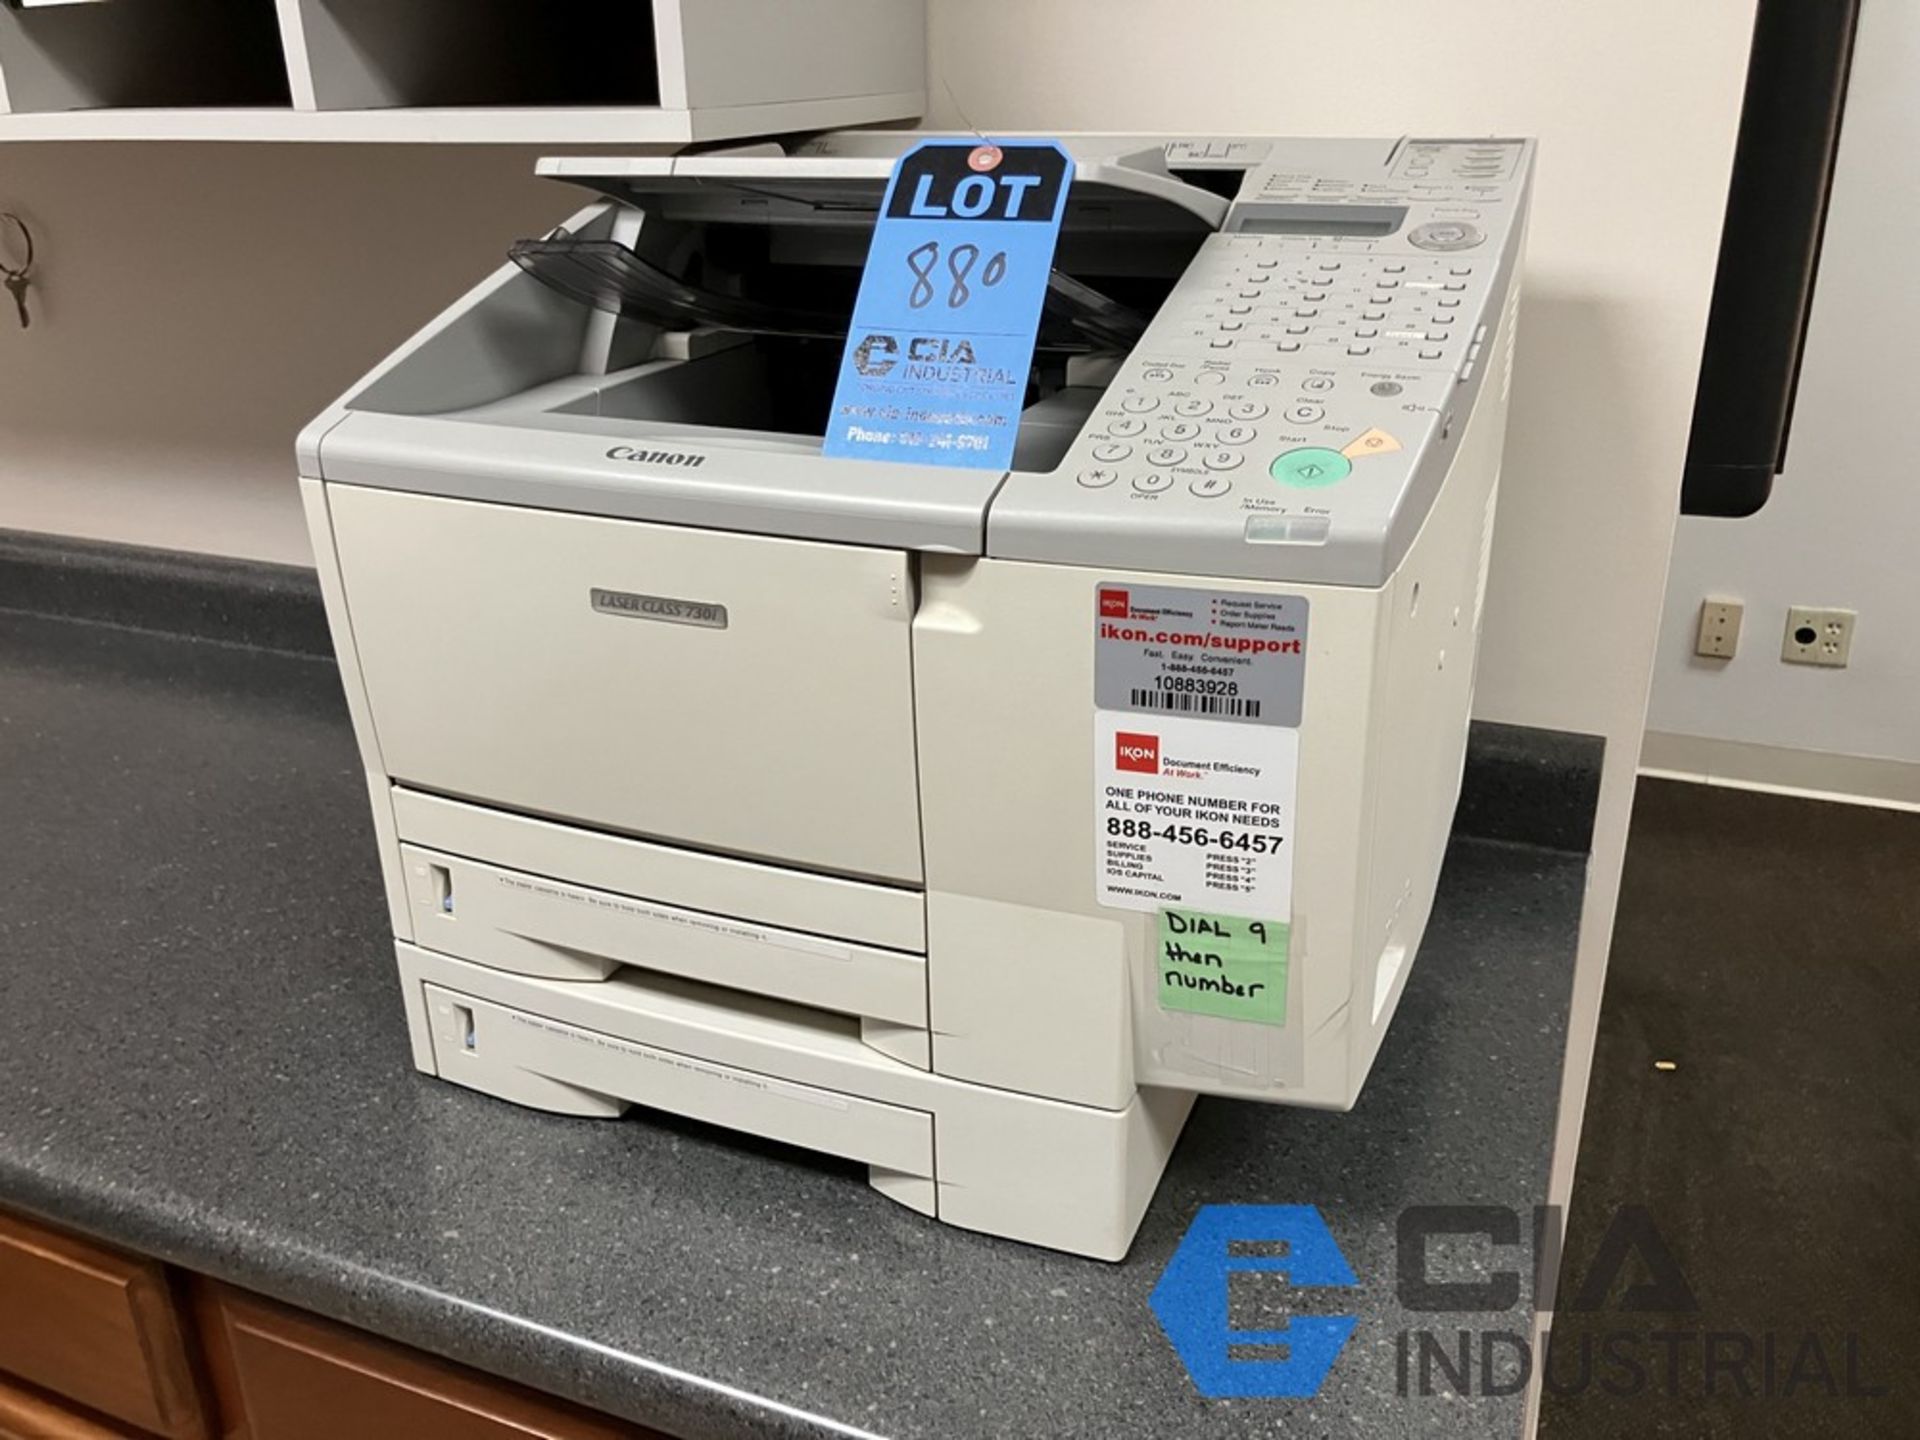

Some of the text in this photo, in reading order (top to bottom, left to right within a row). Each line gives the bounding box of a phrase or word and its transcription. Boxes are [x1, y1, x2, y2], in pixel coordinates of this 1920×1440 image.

[909, 174, 1041, 218] LOT
[907, 241, 1006, 309] 880
[907, 337, 977, 365] CIA
[902, 365, 1017, 385] INDUSTRIAL
[1187, 400, 1201, 410] 2
[1242, 403, 1255, 414] 3
[1297, 406, 1313, 418] C
[1120, 420, 1131, 430] 4
[1174, 424, 1186, 434] 5
[1230, 427, 1242, 438] 6
[1278, 435, 1307, 443] Start
[1106, 444, 1120, 454] 7
[1160, 448, 1174, 460] 8
[606, 446, 706, 467] Canon
[1218, 452, 1231, 463] 9
[1146, 474, 1160, 485] 0
[1255, 497, 1276, 506] Use
[1303, 506, 1331, 515] Error
[600, 594, 640, 612] LASER
[642, 600, 682, 618] CLASS
[1101, 624, 1301, 654] ikon.com/support
[1161, 663, 1235, 676] 1-888-456-6457
[1154, 675, 1239, 696] 10883928
[1120, 746, 1155, 761] IKON
[1163, 757, 1260, 777] Document Efficiency
[1163, 768, 1174, 776] At
[1106, 786, 1281, 815] ONE PHONE NUMBER FOR
[1106, 800, 1280, 829] ALL OF YOUR IKON NEEDS
[1107, 816, 1284, 855] 888-456-6457
[1107, 840, 1147, 852] SERVICE
[1107, 850, 1153, 862] SUPPLIES
[1206, 853, 1240, 864] PRESS
[1107, 859, 1144, 870] BILLING
[1206, 862, 1240, 874] PRESS
[1107, 868, 1164, 882] IOS CAPITAL
[1206, 872, 1240, 882] PRESS
[1206, 881, 1240, 892] PRESS
[1107, 885, 1182, 901] WWW.IKON.COM
[1165, 911, 1266, 944] DIAL 9
[1165, 941, 1222, 968] then
[1165, 970, 1265, 998] number
